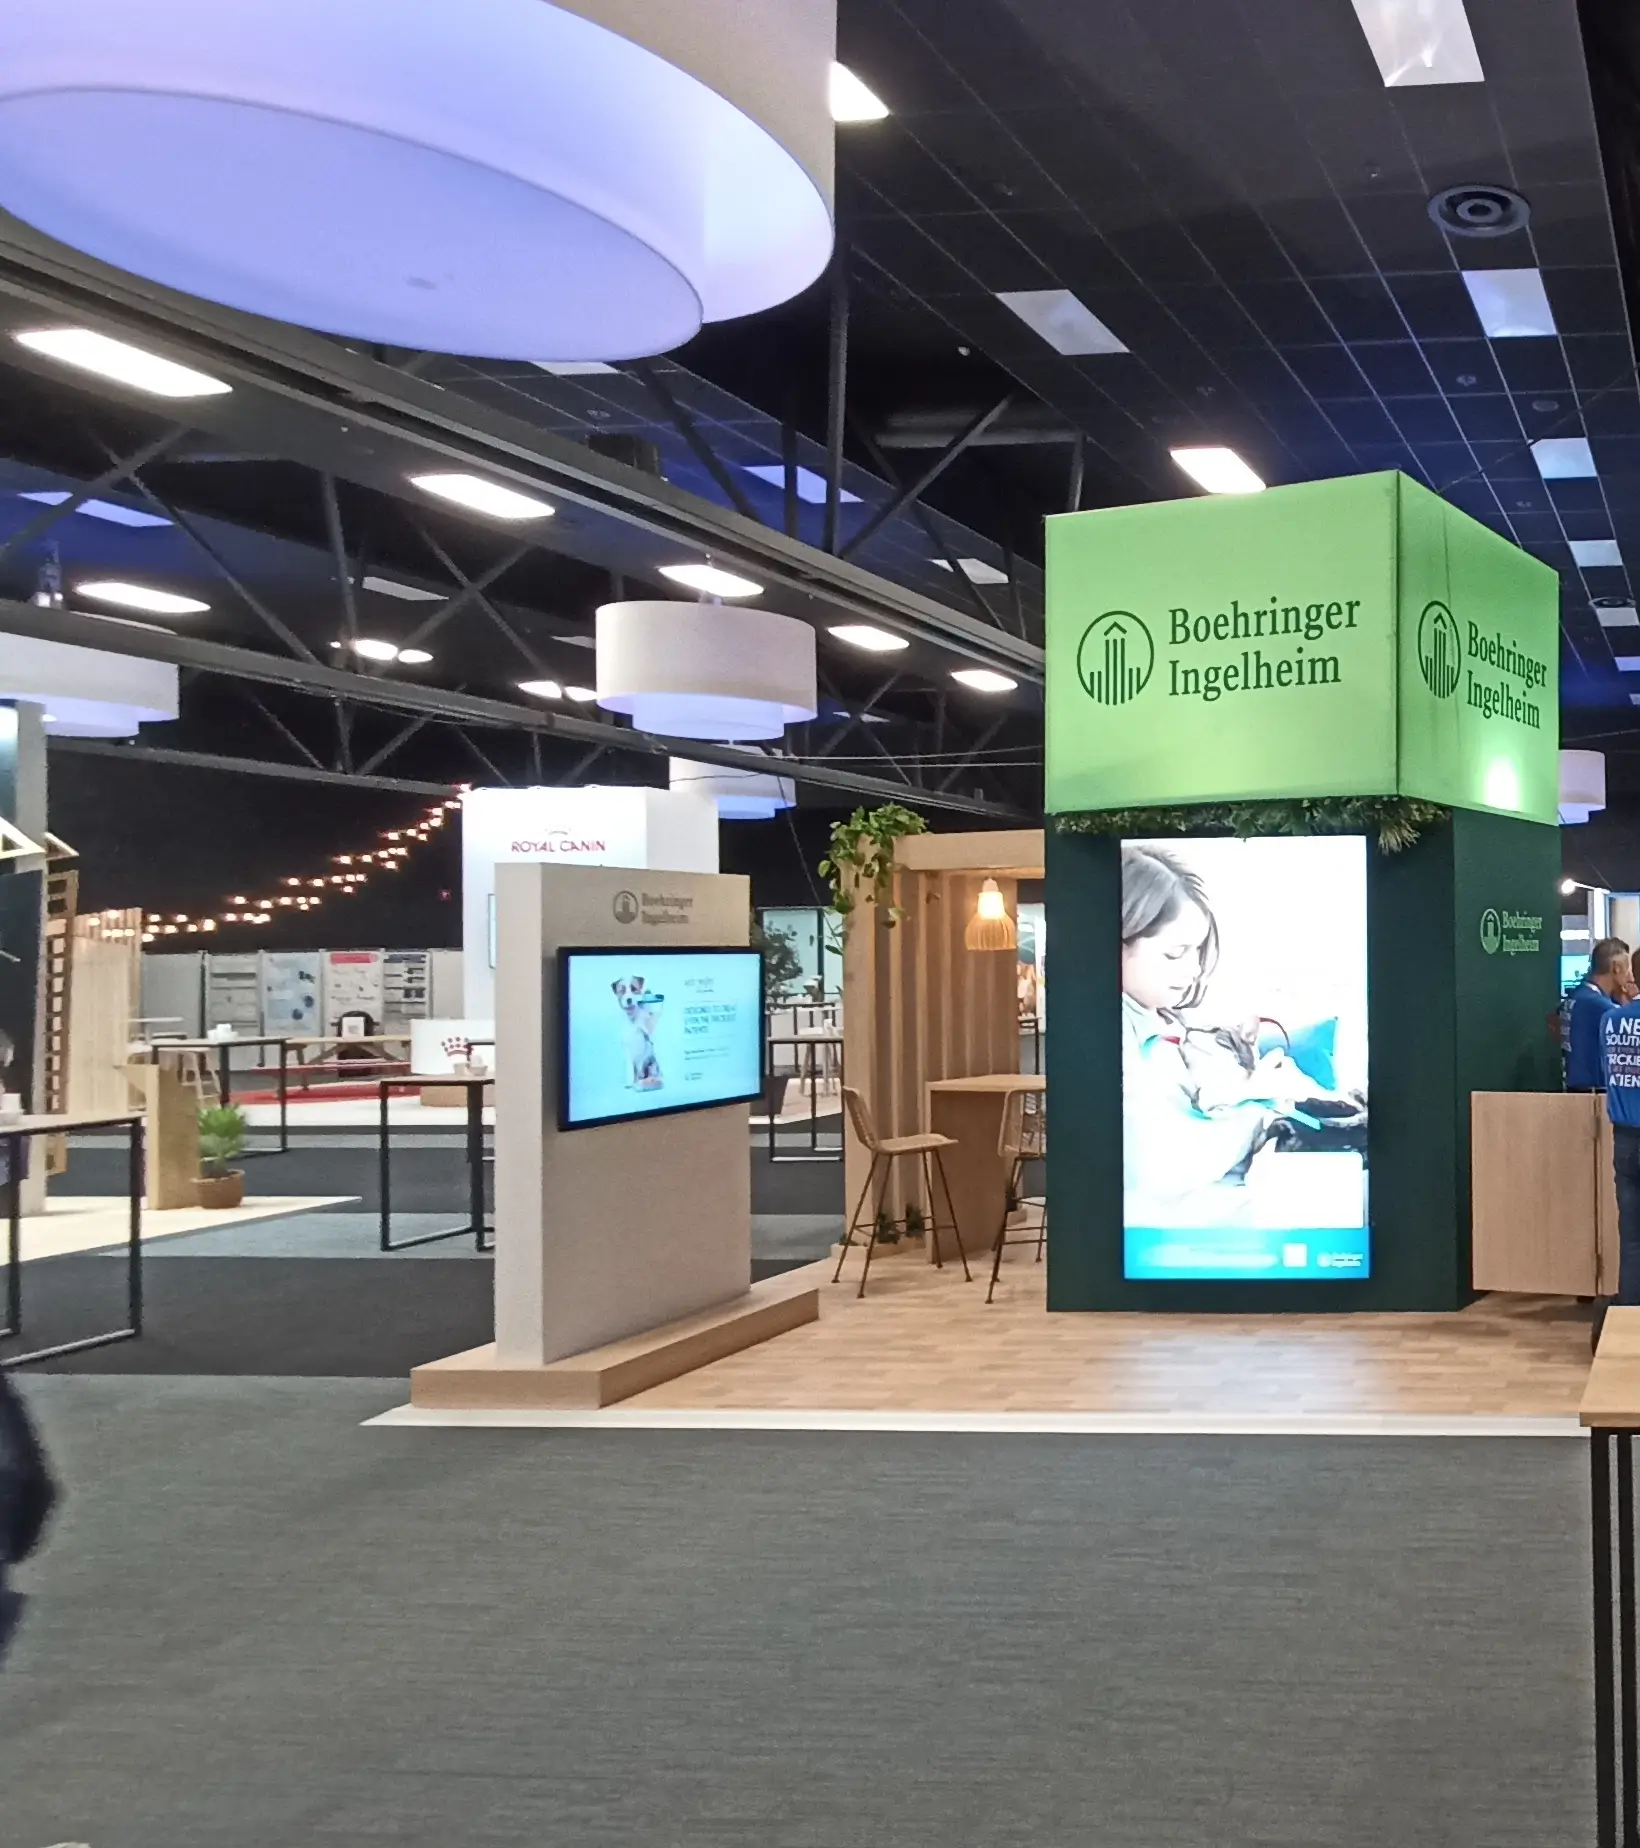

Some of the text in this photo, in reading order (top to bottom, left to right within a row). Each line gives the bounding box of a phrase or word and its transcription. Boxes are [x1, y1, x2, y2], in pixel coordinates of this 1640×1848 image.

[1168, 595, 1361, 645] Boehringer
[1168, 646, 1342, 702] Ingelheim
[1467, 620, 1547, 689] Boehringer
[1466, 669, 1541, 730] Ingelheim
[510, 840, 606, 853] ROYAL CANIN
[1605, 1016, 1615, 1034] A
